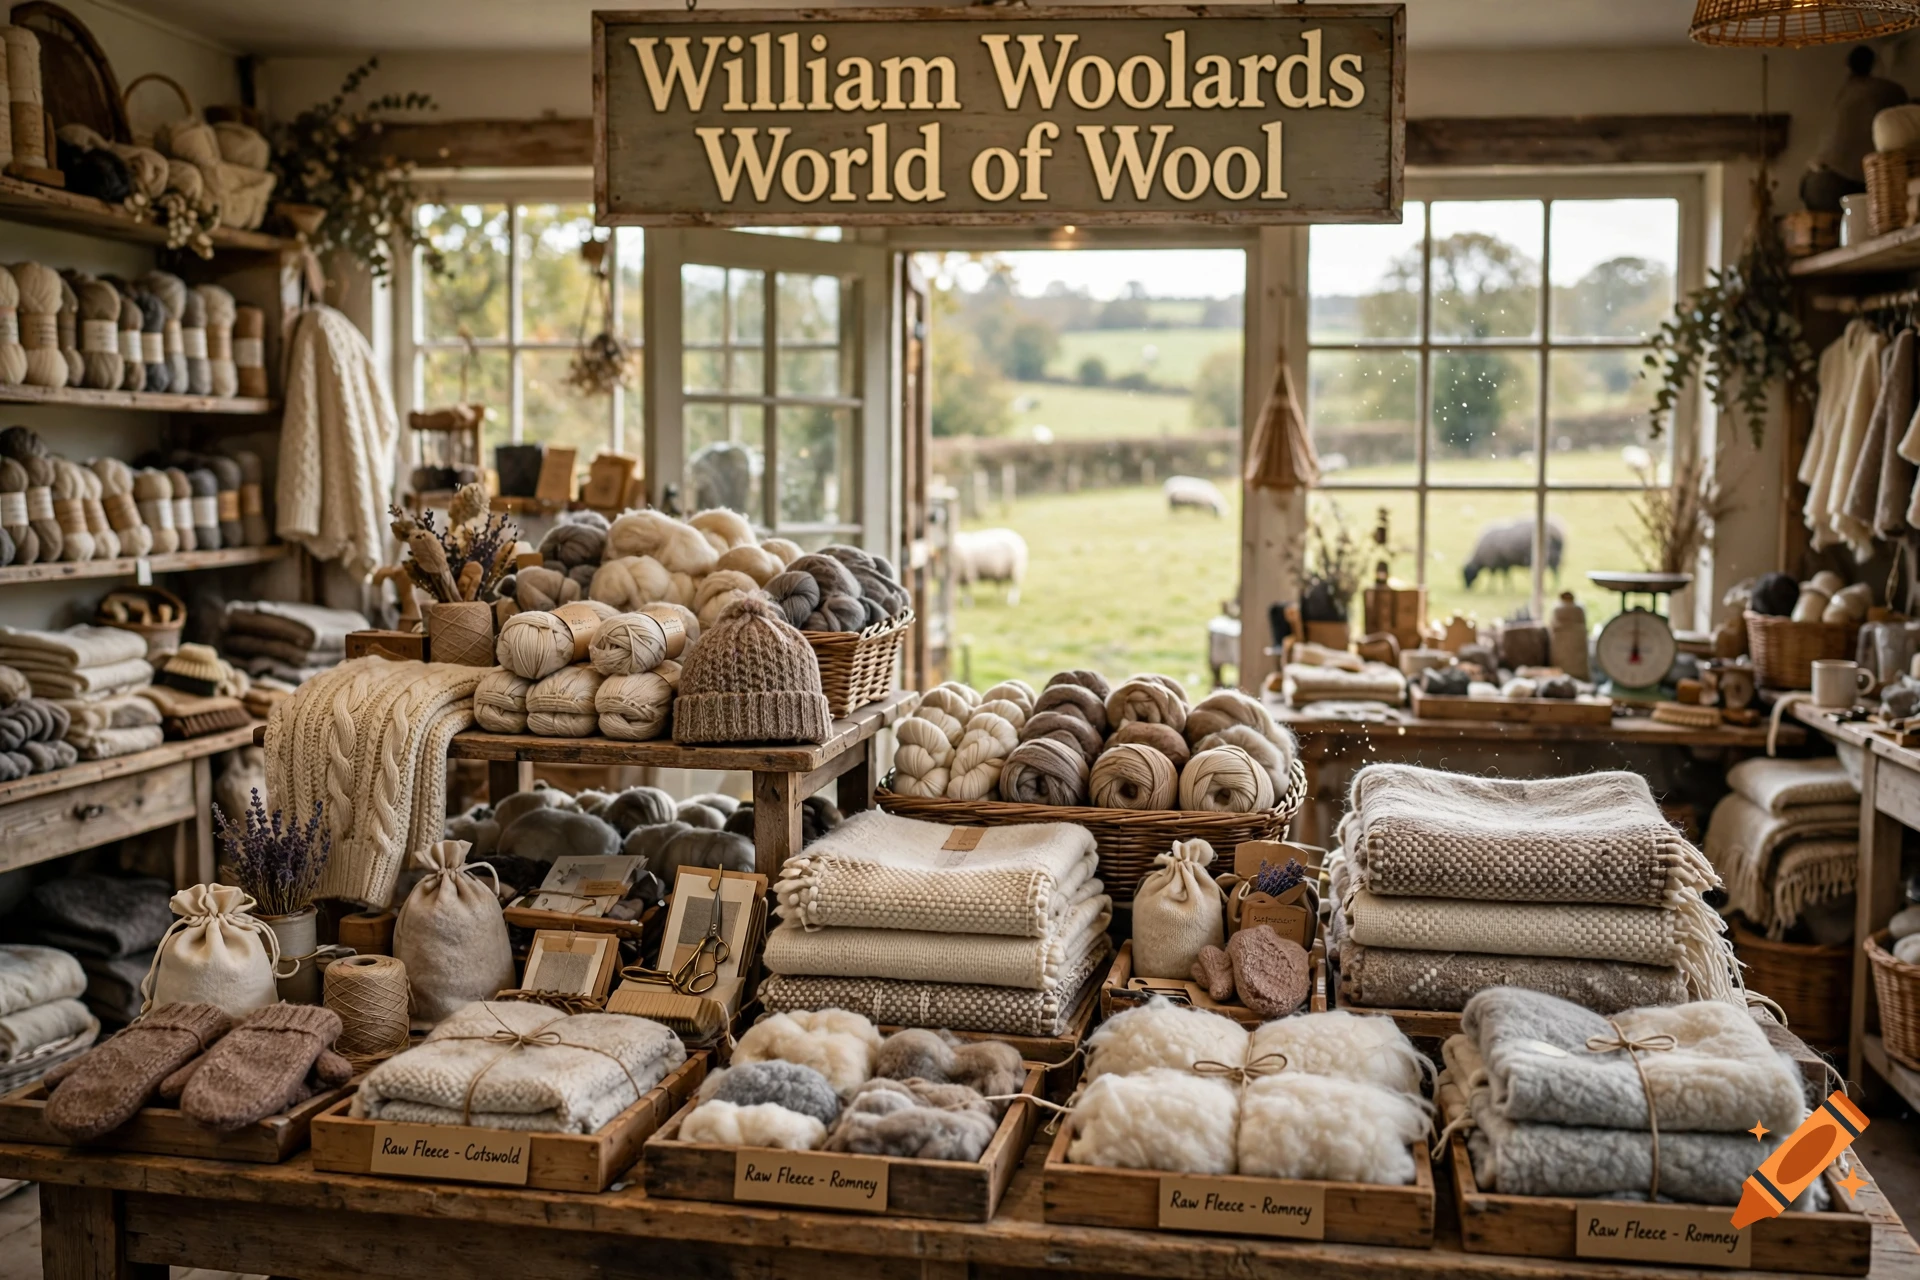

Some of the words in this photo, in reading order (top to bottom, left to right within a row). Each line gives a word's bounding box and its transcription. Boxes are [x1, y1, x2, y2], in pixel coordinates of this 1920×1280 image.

[630, 32, 962, 111] William
[981, 29, 1365, 109] Woolards
[696, 122, 947, 202] World
[971, 121, 1060, 201] of
[1076, 121, 1288, 200] Wool
[381, 1137, 409, 1156] Raw
[412, 1139, 450, 1159] Fleece
[464, 1143, 522, 1165] Cotswold
[744, 1163, 773, 1183] Raw
[776, 1166, 815, 1186] Fleece
[829, 1169, 878, 1200] Romney
[1170, 1189, 1200, 1209] Raw
[1204, 1193, 1245, 1213] Fleece
[1261, 1195, 1313, 1226] Romney
[1587, 1217, 1620, 1238] Raw
[1624, 1219, 1668, 1242] Fleece
[1684, 1223, 1740, 1254] Romney
